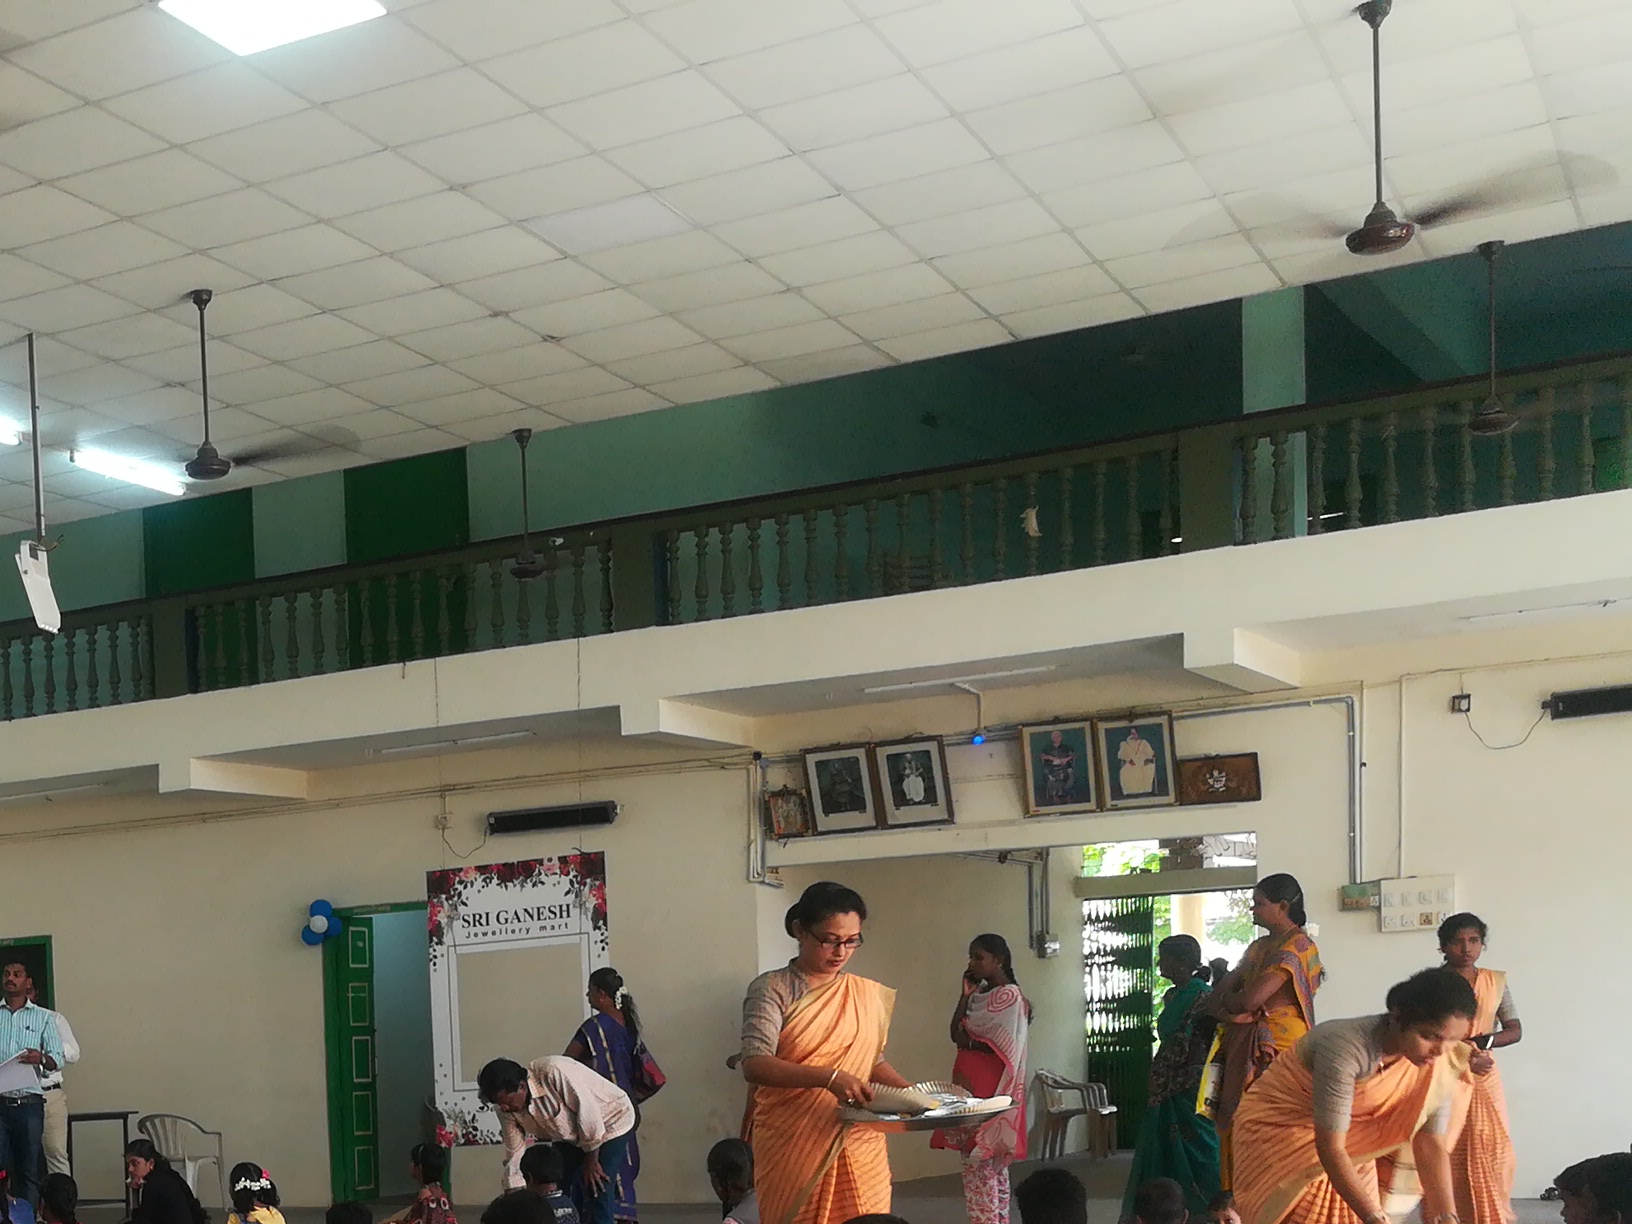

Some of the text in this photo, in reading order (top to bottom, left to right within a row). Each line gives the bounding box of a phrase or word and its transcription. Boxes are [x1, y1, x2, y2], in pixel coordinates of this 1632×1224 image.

[461, 903, 571, 929] SRI GANESH
[539, 922, 569, 932] mart
